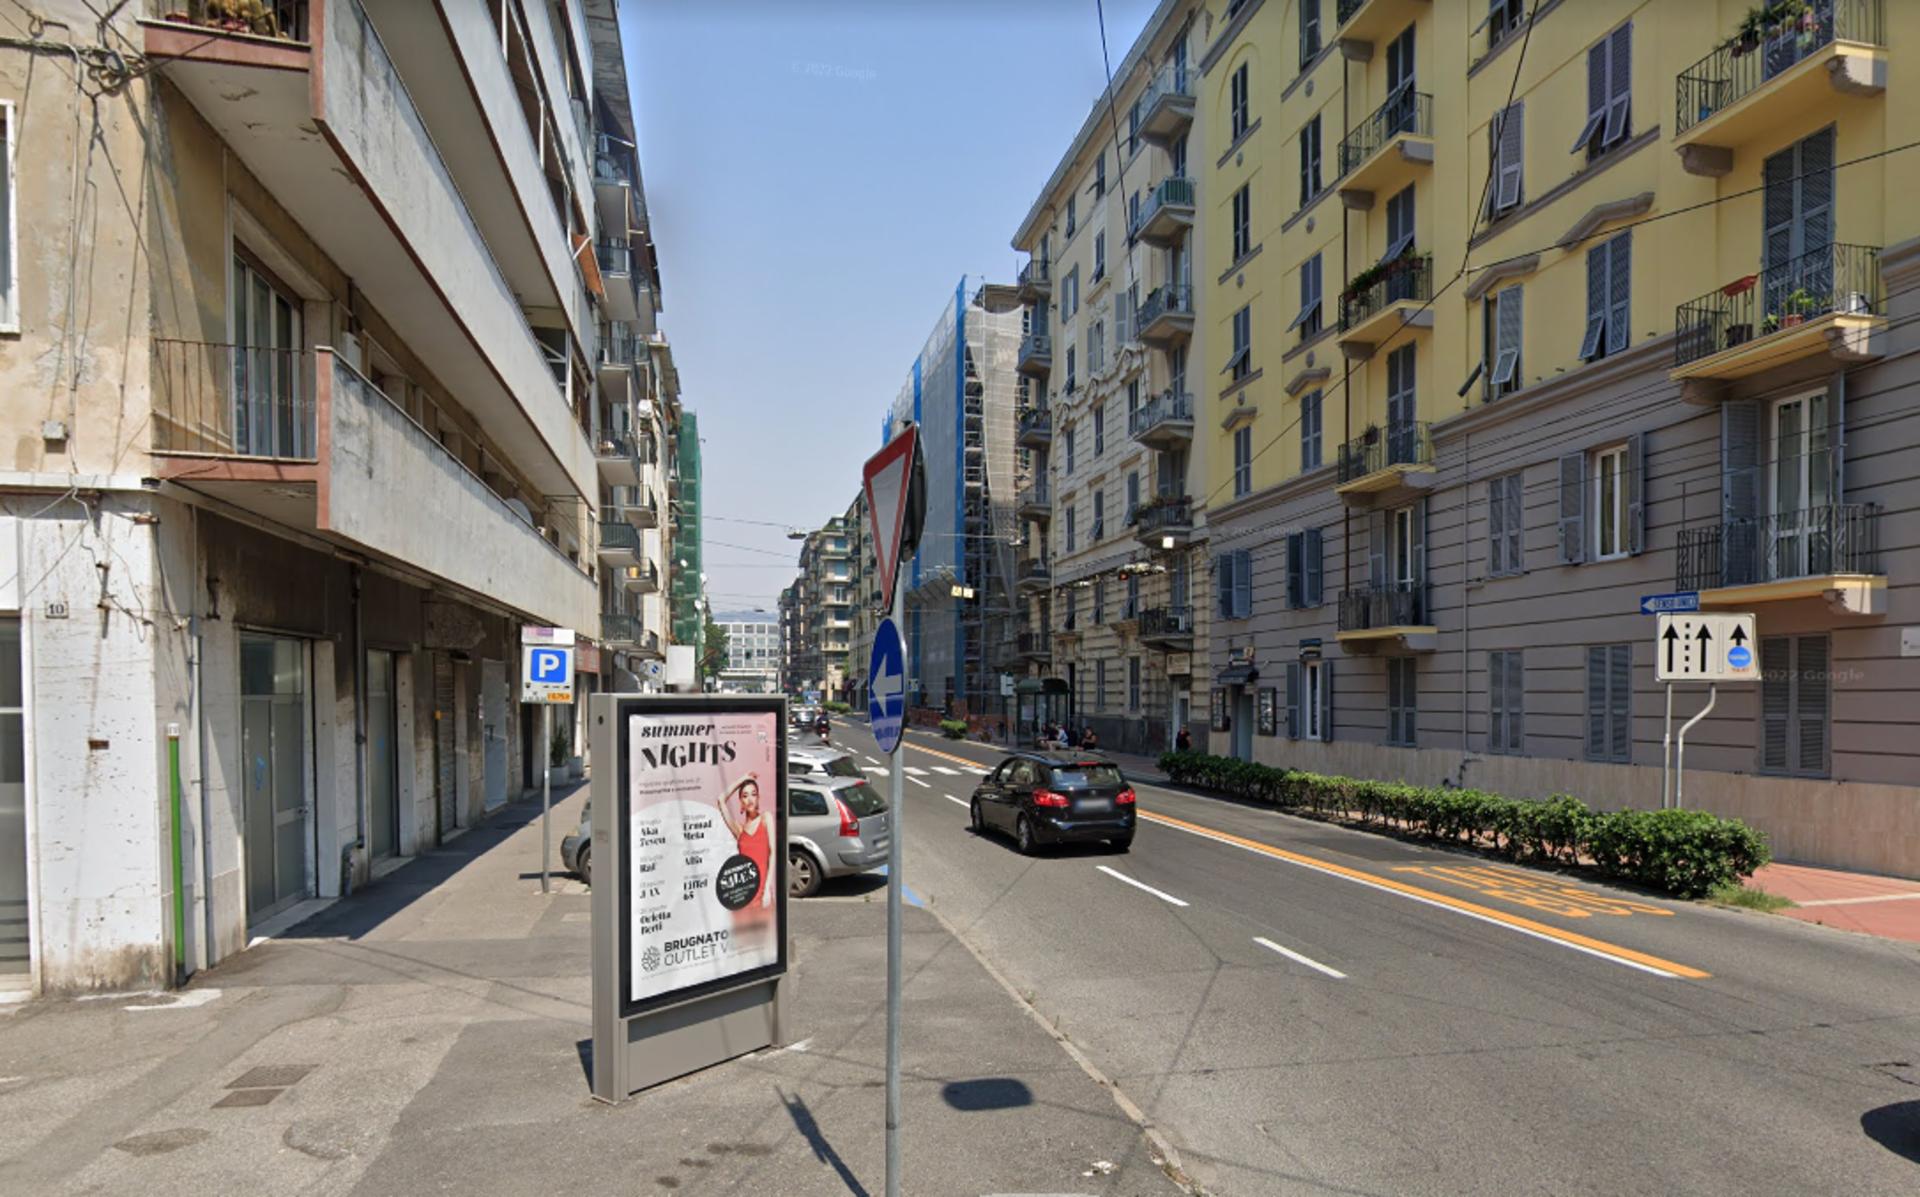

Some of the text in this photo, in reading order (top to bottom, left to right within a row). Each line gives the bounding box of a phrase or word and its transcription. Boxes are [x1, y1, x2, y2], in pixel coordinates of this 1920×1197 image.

[49, 603, 65, 615] 10
[538, 653, 560, 679] P
[641, 724, 716, 738] summer
[641, 740, 737, 770] NIGHTS
[663, 929, 729, 953] BRUGNATO
[663, 944, 717, 967] OUTLET
